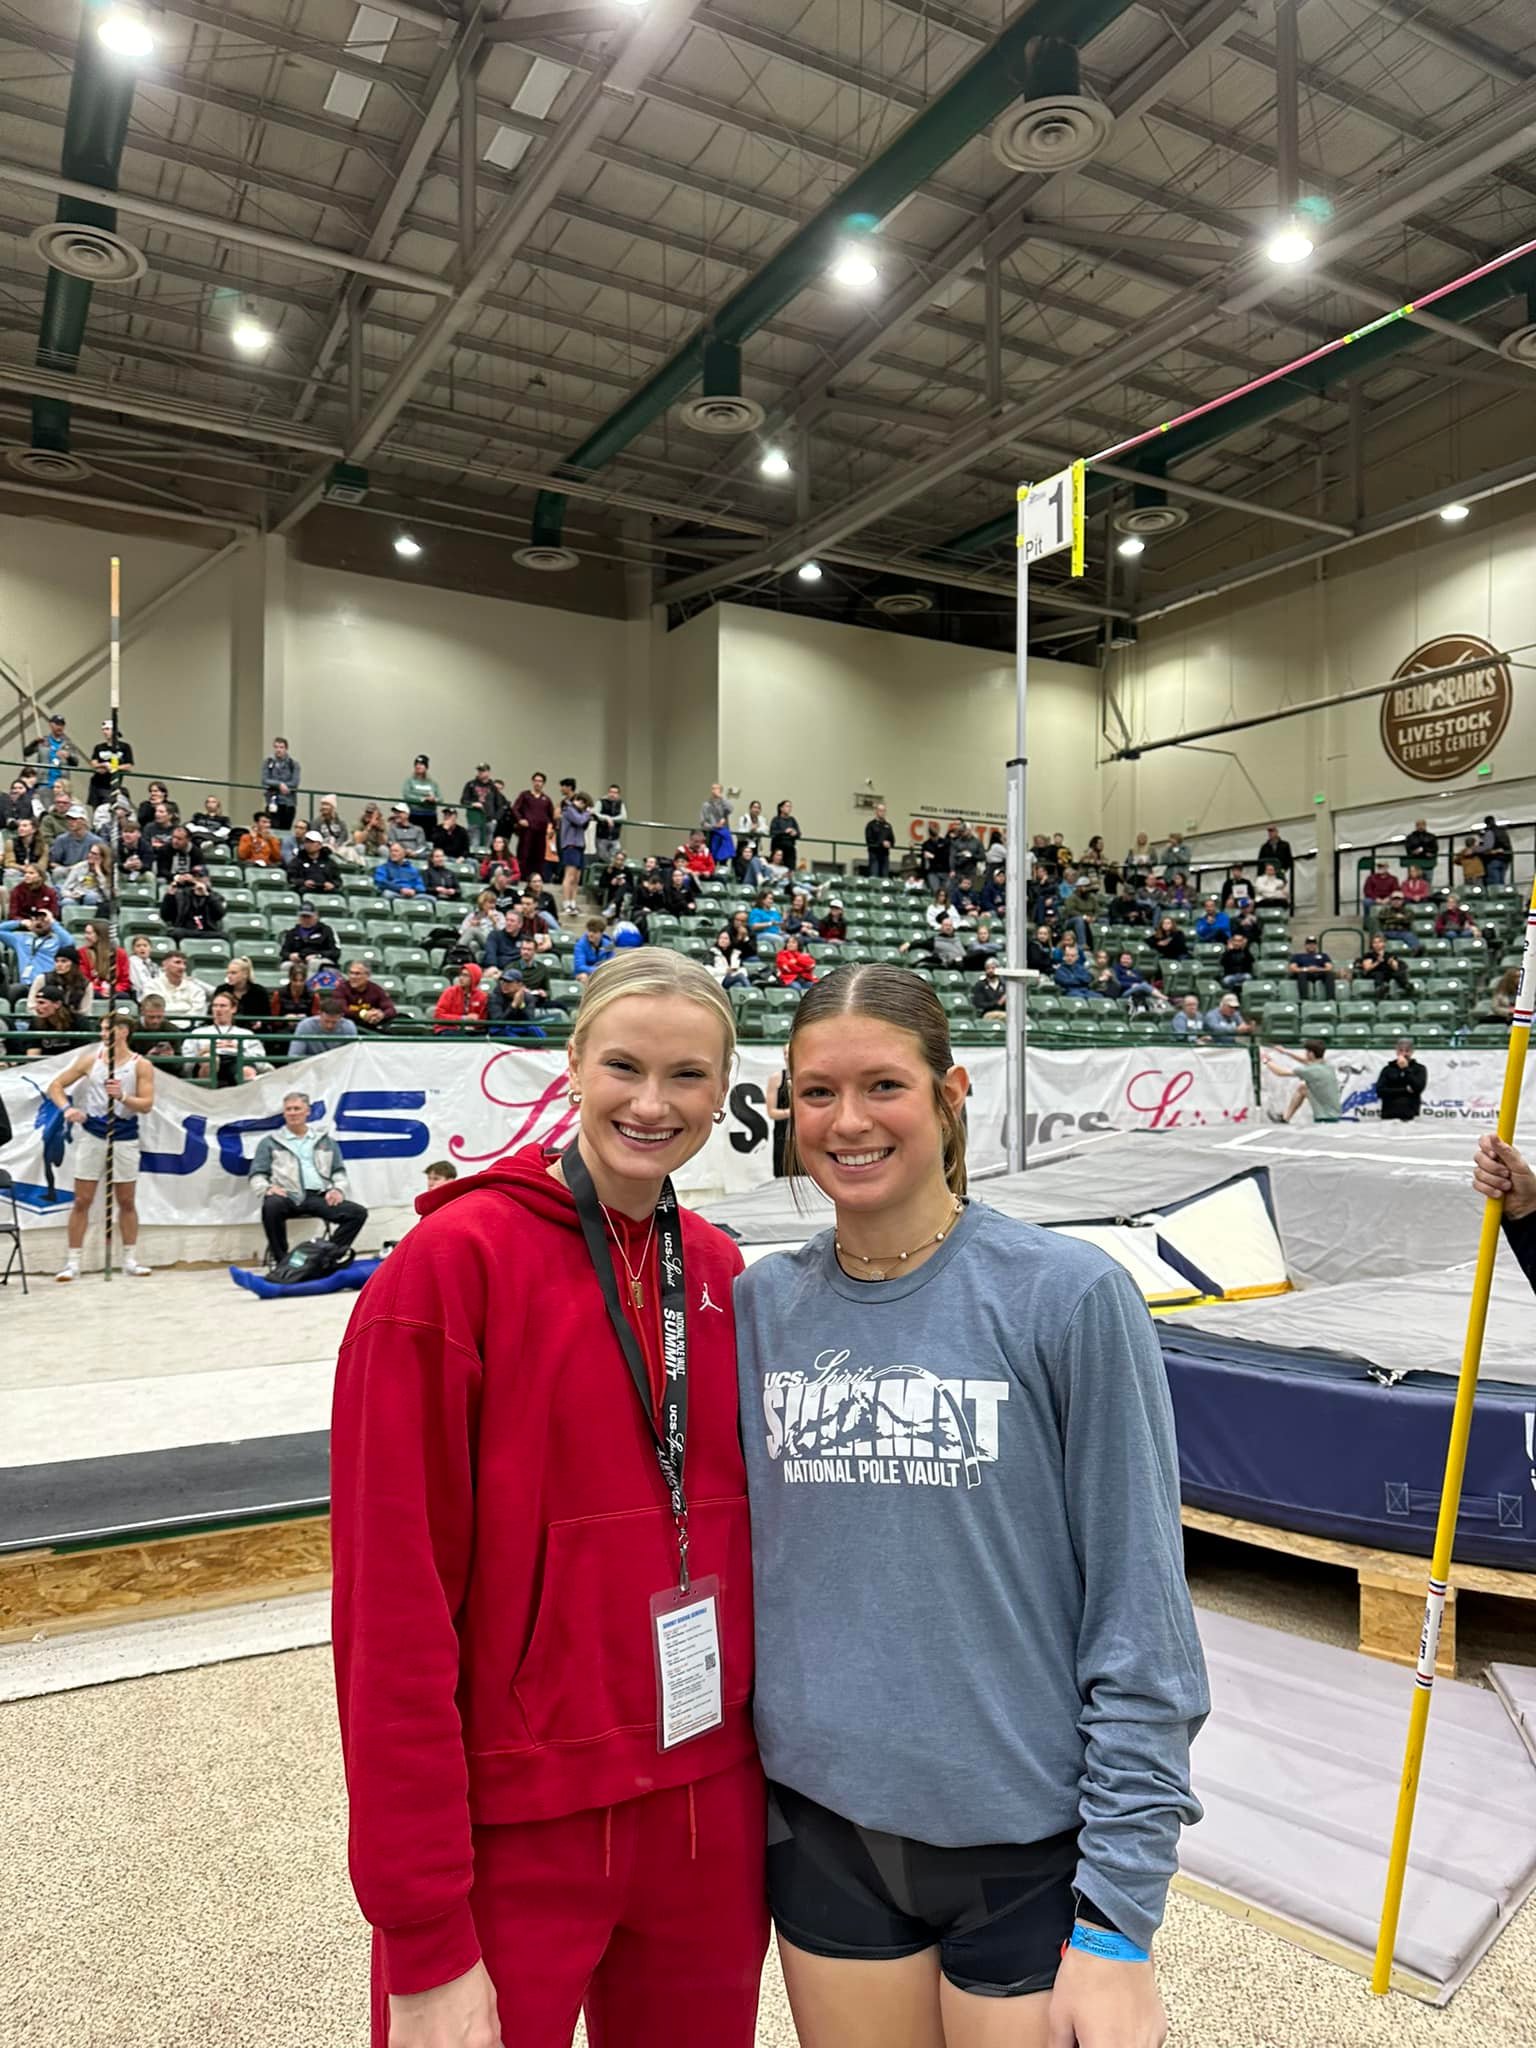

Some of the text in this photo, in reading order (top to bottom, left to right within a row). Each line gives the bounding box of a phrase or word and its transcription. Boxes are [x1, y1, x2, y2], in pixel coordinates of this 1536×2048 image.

[1048, 480, 1064, 545] 1
[1025, 538, 1043, 560] Pit
[1398, 710, 1493, 746] LIVESTOCK
[1402, 739, 1442, 762] EVENTS
[1445, 730, 1488, 753] CENTER
[663, 1232, 674, 1255] UCS
[661, 1255, 683, 1288] Spirit
[663, 1307, 678, 1381] SUMMIT
[675, 1311, 687, 1376] NATIONAL POLE VAULT
[763, 1349, 874, 1398] UCS Spirit
[669, 1404, 679, 1430] UCS
[762, 1379, 1010, 1463] SUMMIT
[783, 1460, 961, 1488] NATIONAL POLE VAULT
